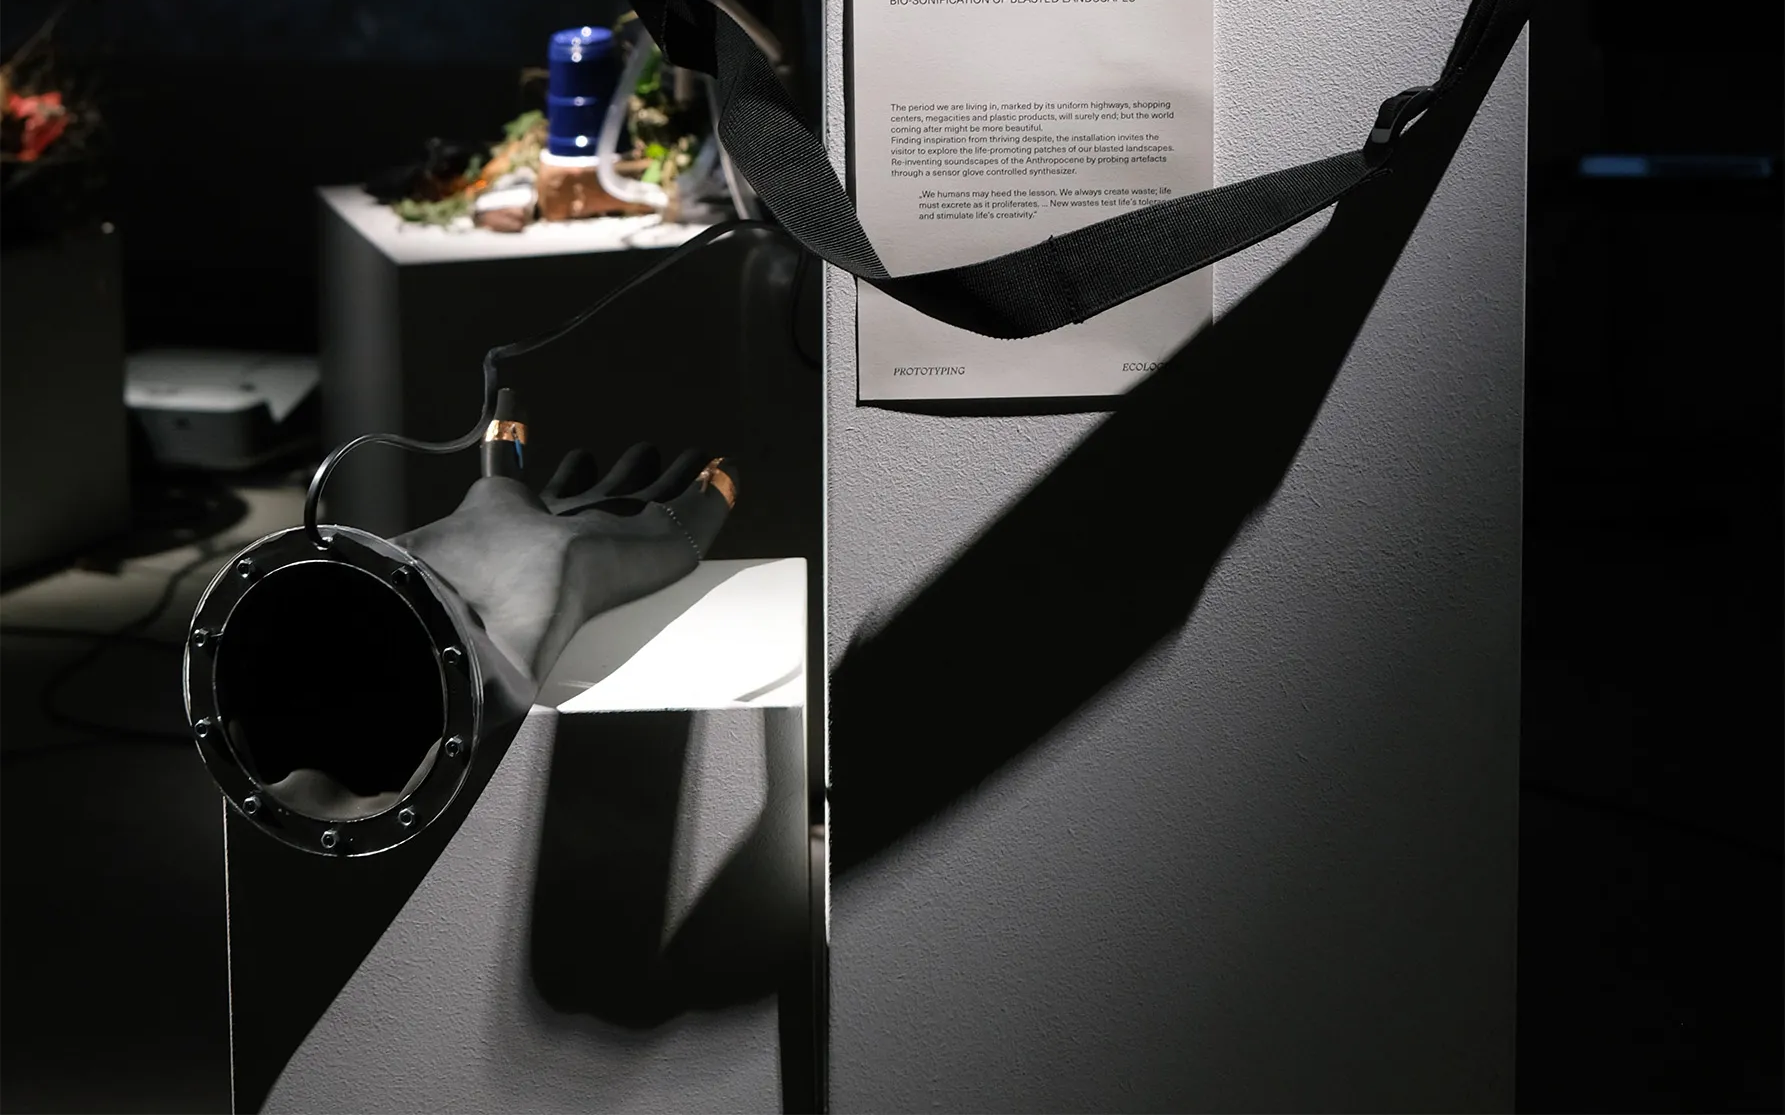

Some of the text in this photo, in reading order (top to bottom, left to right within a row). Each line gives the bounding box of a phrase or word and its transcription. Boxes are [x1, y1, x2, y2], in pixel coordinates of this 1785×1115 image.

[890, 102, 906, 112] The
[907, 102, 935, 113] period
[965, 102, 988, 113] living
[988, 102, 999, 111] in,
[1000, 101, 1032, 110] marked
[1033, 101, 1044, 112] by
[1044, 101, 1055, 110] its
[1056, 101, 1089, 110] uniform
[1090, 100, 1131, 113] highways,
[1132, 99, 1171, 112] shopping
[890, 114, 924, 124] centers,
[924, 113, 971, 124] megacities
[971, 112, 988, 122] and
[988, 112, 1017, 123] plastic
[1017, 112, 1057, 122] products,
[1058, 112, 1073, 120] will
[1074, 111, 1100, 122] surely
[1120, 110, 1134, 120] but
[1135, 111, 1150, 119] the
[1150, 110, 1174, 119] world
[890, 124, 922, 135] coming
[922, 124, 942, 133] after
[943, 124, 968, 134] might
[969, 124, 980, 132] be
[1004, 123, 1043, 132] beautiful.
[890, 132, 1159, 146] Finding inspiration from thriving despite, the installation invites the
[890, 146, 916, 155] visitor
[916, 147, 926, 155] to
[926, 146, 958, 156] explore
[959, 146, 973, 154] the
[974, 145, 1032, 156] life-promoting
[1033, 145, 1066, 155] patches
[1067, 144, 1076, 153] of
[1093, 144, 1124, 153] blasted
[1125, 143, 1174, 156] landscapes.
[891, 154, 1167, 168] Re-inventing soundscapes of the Anthropocene by probing artefacts
[890, 168, 924, 179] through
[931, 169, 961, 177] sensor
[961, 167, 984, 178] glove
[985, 167, 1027, 176] controlled
[1028, 166, 1077, 177] synthesizer.
[936, 189, 970, 198] humans
[971, 190, 990, 199] may
[990, 188, 1012, 198] heed
[1013, 188, 1027, 197] the
[1028, 188, 1058, 197] lesson.
[1058, 187, 1073, 196] We
[1073, 187, 1102, 198] always
[1103, 188, 1130, 196] create
[1130, 187, 1158, 196] waste;
[1158, 186, 1172, 195] life
[918, 201, 940, 209] must
[940, 201, 971, 209] excrete
[984, 200, 990, 208] it
[1049, 198, 1069, 208] New
[1069, 199, 1100, 207] wastes
[1100, 198, 1116, 206] test
[918, 211, 935, 220] and
[935, 211, 974, 220] stimulate
[892, 365, 965, 376] PROTOTYPING
